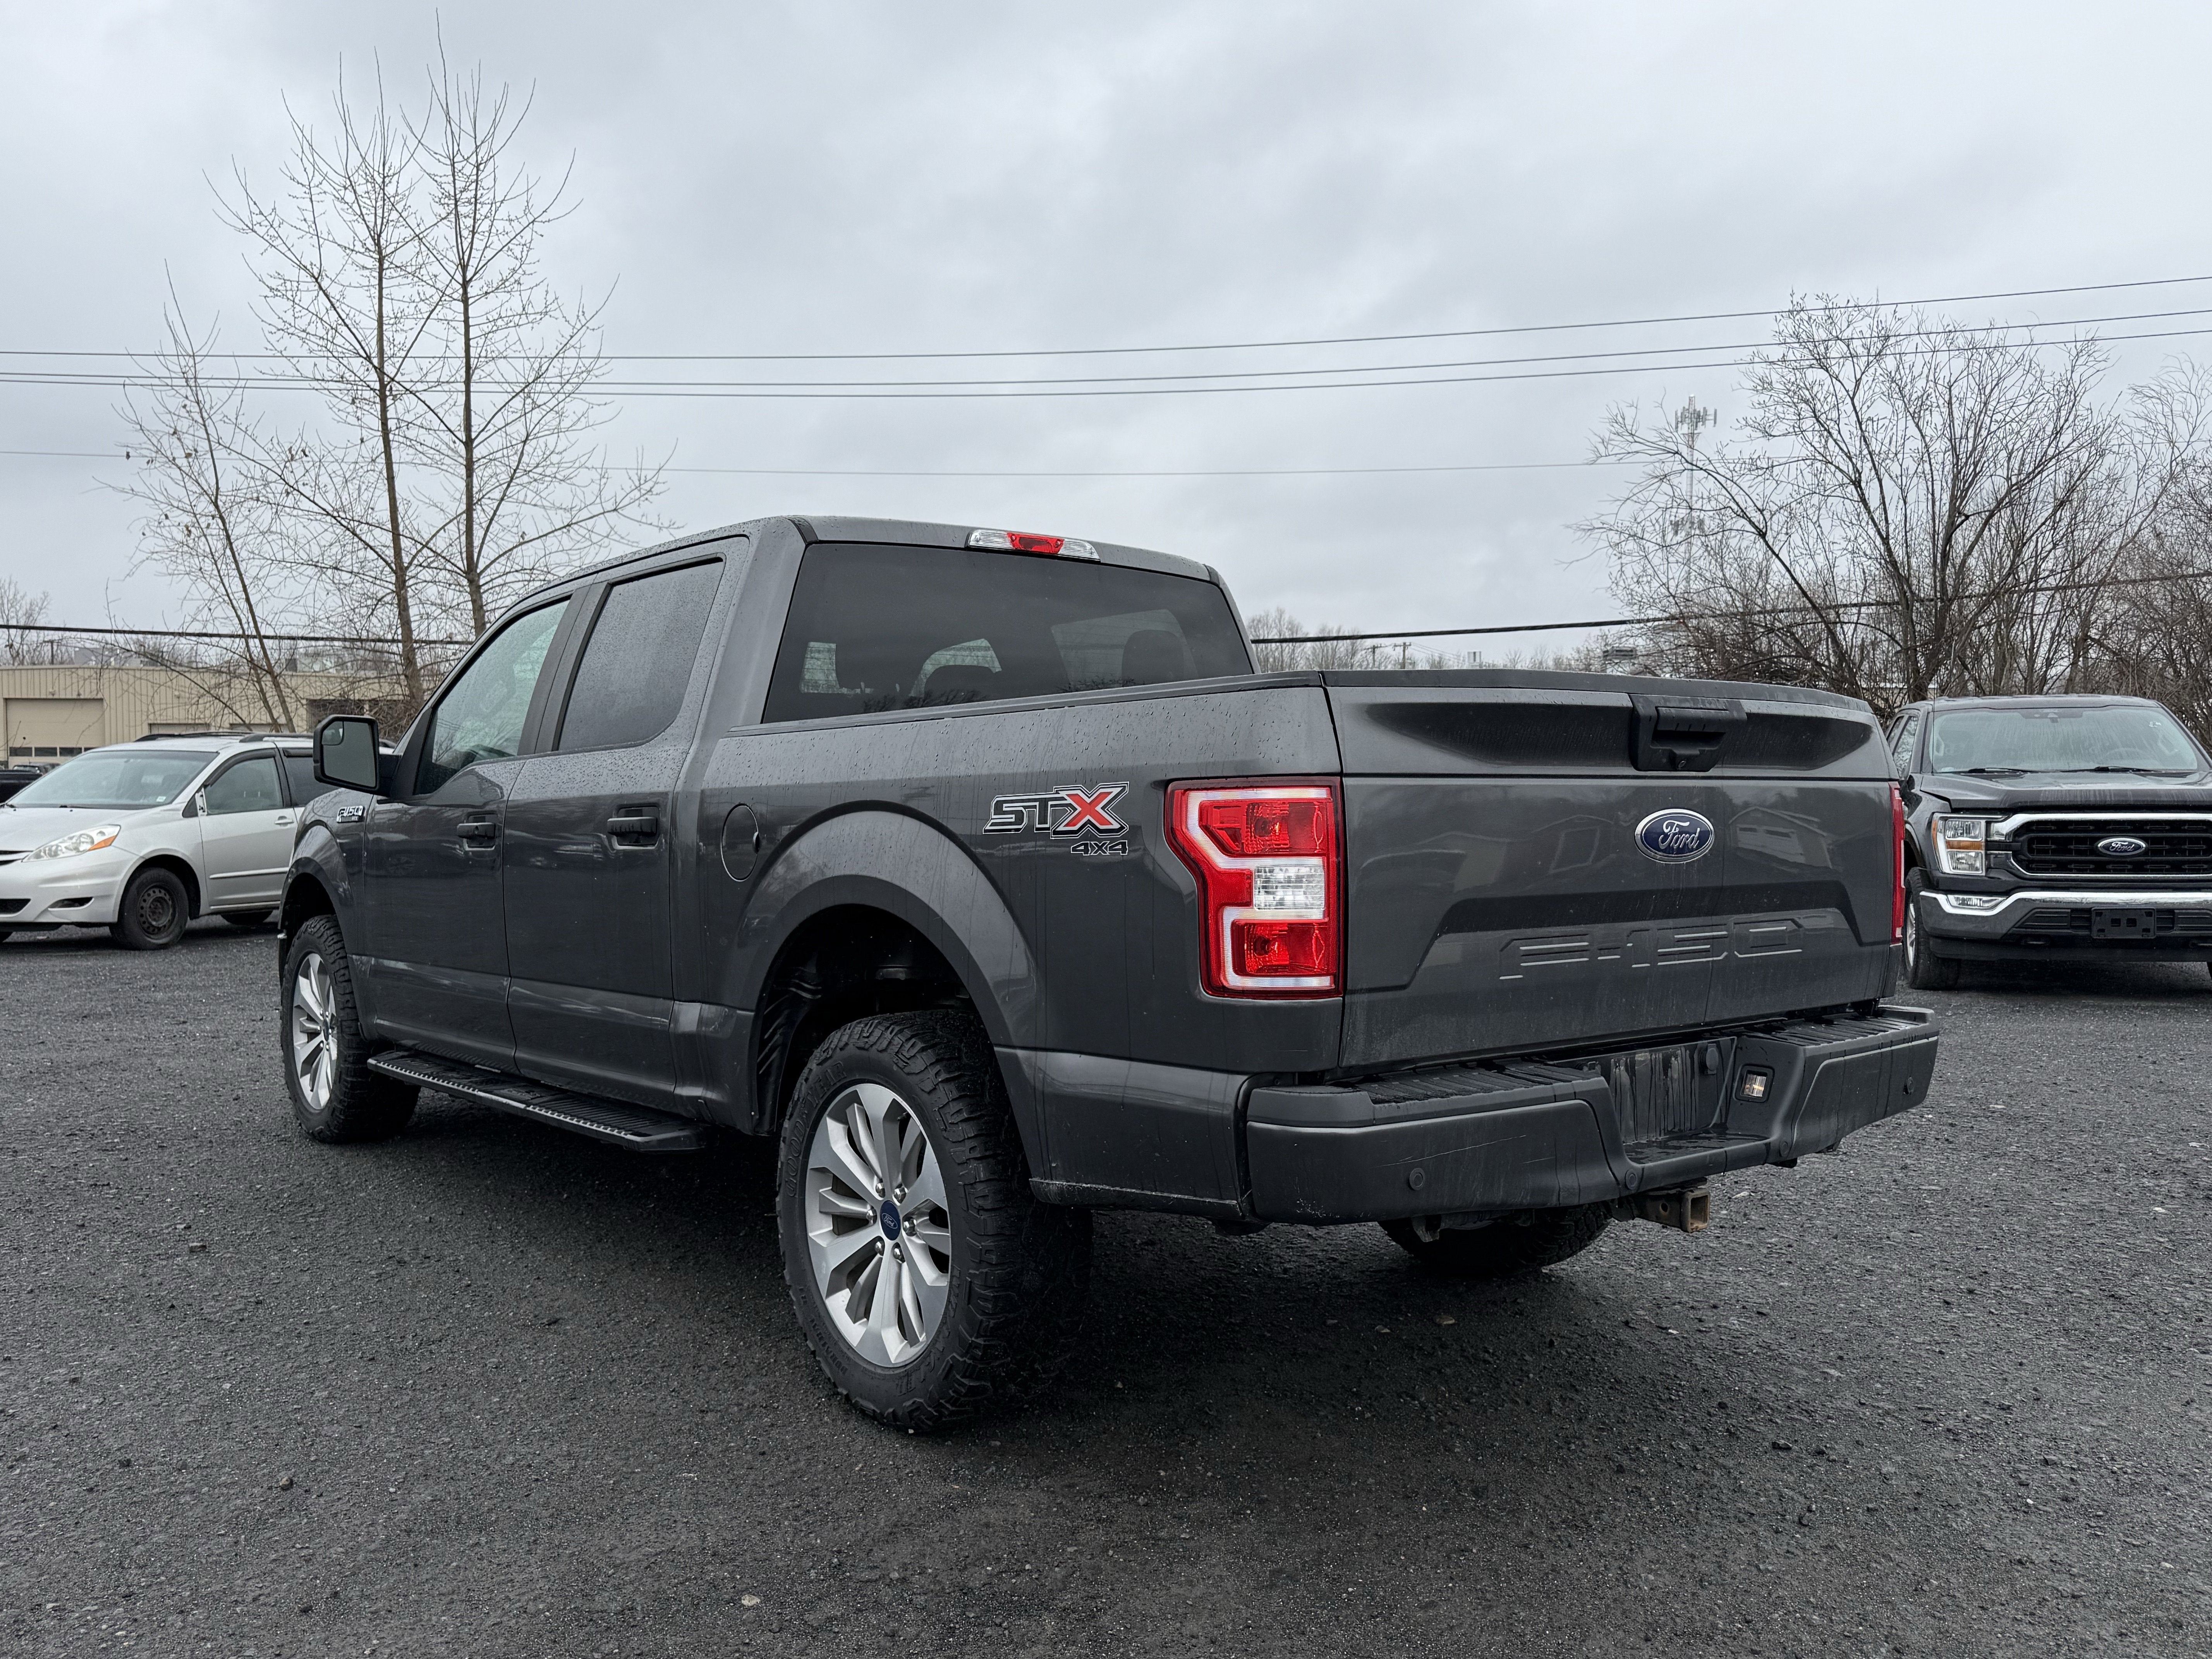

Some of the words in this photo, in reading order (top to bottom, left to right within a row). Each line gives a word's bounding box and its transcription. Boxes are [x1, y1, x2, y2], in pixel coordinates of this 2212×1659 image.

[982, 781, 1130, 839] STX
[1658, 820, 1700, 849] Ford
[2109, 842, 2135, 851] Ford
[884, 1215, 895, 1227] Ford
